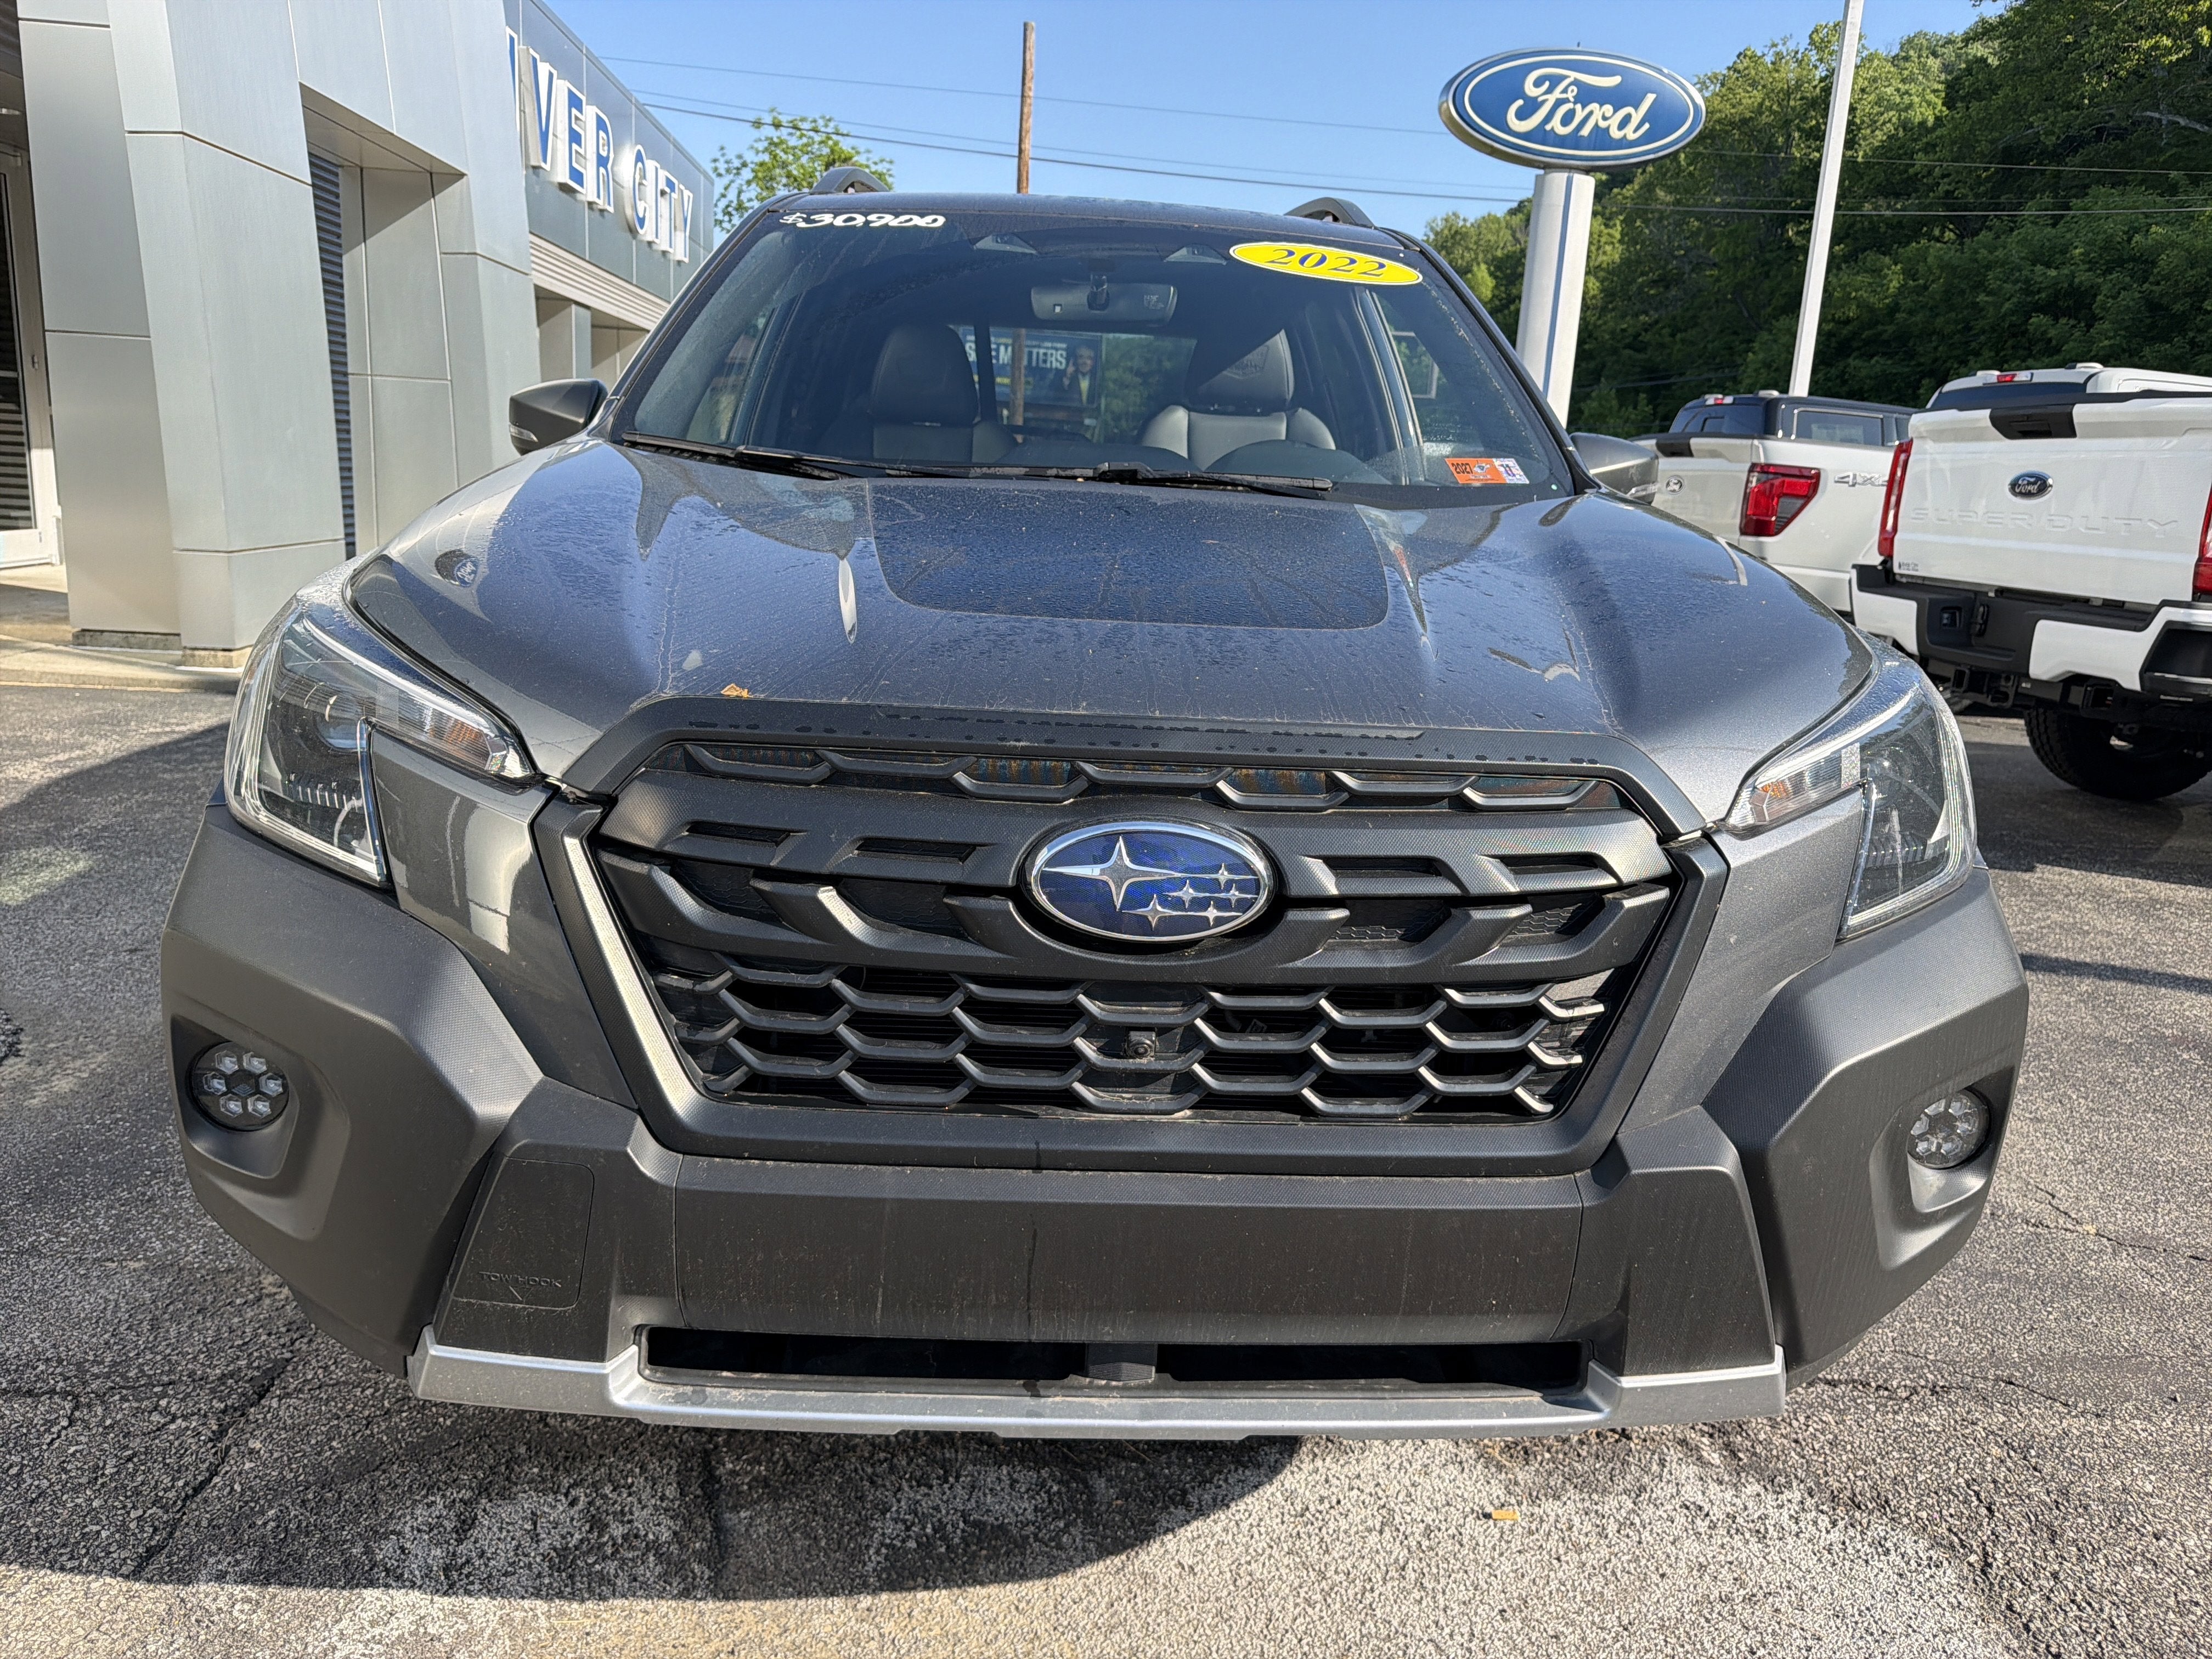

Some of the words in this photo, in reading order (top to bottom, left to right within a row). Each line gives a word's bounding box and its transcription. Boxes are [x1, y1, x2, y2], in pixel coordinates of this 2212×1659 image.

[1506, 67, 1657, 141] Ford
[627, 144, 693, 263] CITY
[1264, 248, 1387, 277] 2022
[965, 342, 997, 364] SE
[999, 345, 1067, 369] MTTERS
[1451, 462, 1474, 475] 2027
[2015, 476, 2041, 493] Ford
[1911, 507, 2033, 529] SUPER
[2045, 514, 2178, 538] DUTY
[479, 1271, 512, 1282] TOW
[517, 1276, 562, 1288] HOOK
